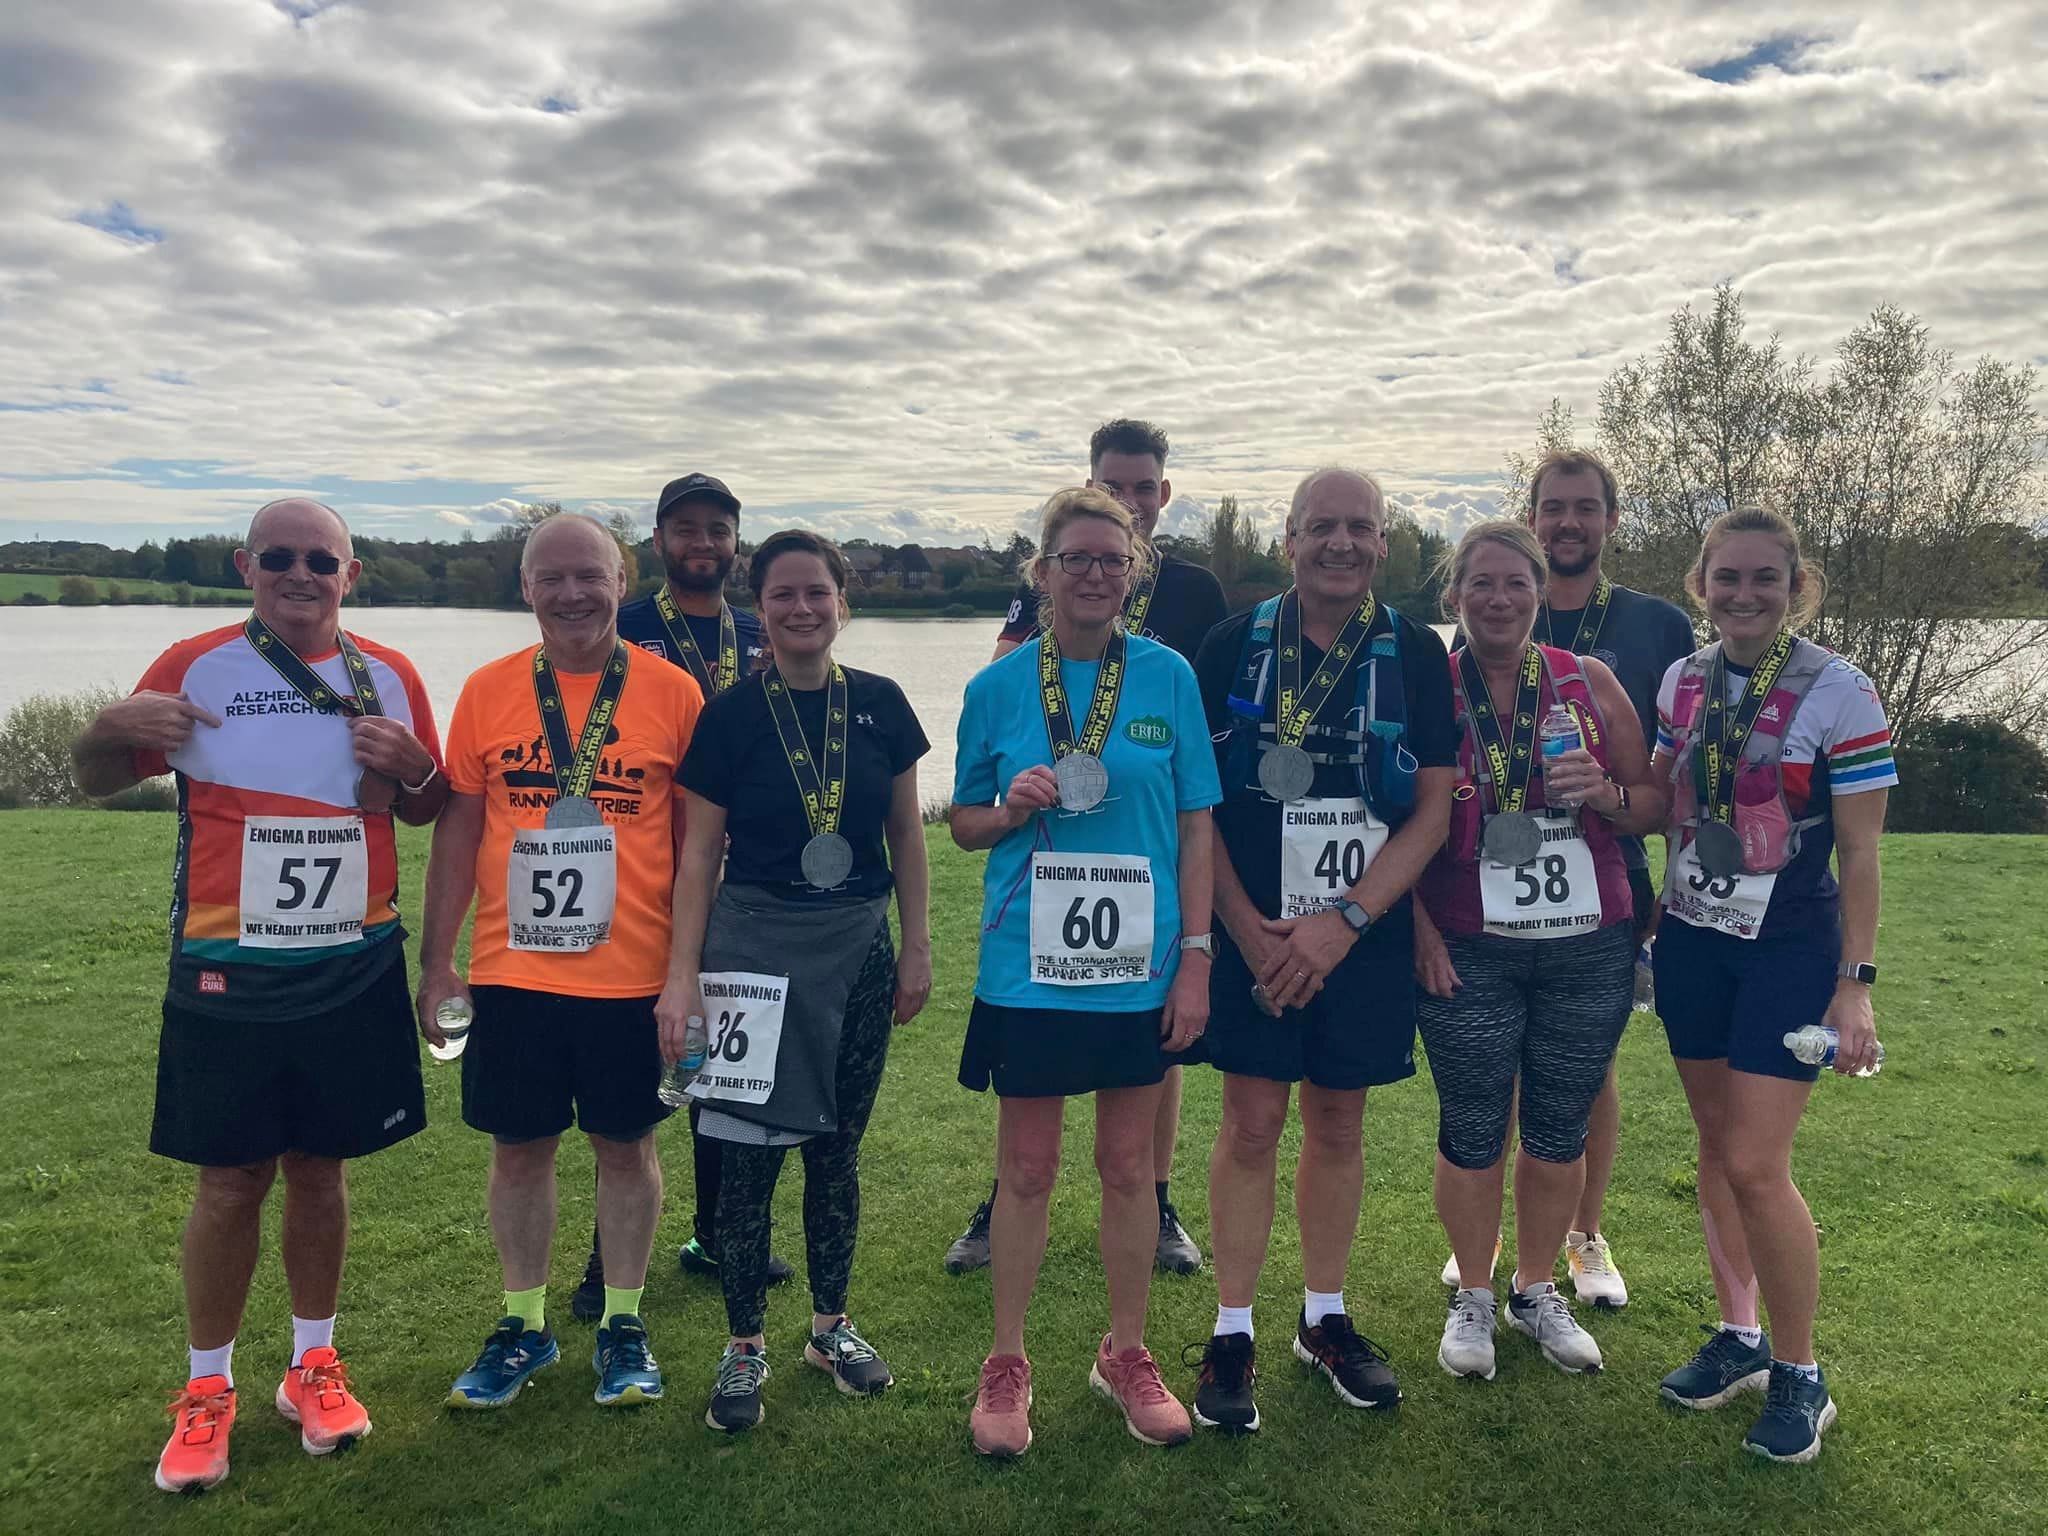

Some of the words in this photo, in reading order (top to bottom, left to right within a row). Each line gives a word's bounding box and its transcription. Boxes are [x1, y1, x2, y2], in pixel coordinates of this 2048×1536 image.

[1134, 595, 1148, 617] RUN
[725, 647, 736, 668] RUN
[1106, 661, 1121, 688] RUN
[1753, 655, 1782, 696] DEATH
[232, 690, 306, 704] ALZHEIM
[1044, 686, 1059, 714] RUN
[1099, 689, 1115, 720] STAR
[225, 702, 314, 718] RESEARCH
[586, 725, 605, 761] STAR
[596, 699, 614, 725] RUN
[1291, 709, 1312, 737] RUN
[1086, 721, 1107, 753] EATH
[828, 780, 841, 808] RUN
[1286, 811, 1338, 826] ENIGMA
[249, 827, 305, 844] ENIGMA
[307, 827, 362, 844] RUNNING
[552, 838, 613, 855] RUNNING
[1314, 838, 1365, 889] 40
[276, 857, 343, 910] 57
[1035, 866, 1087, 881] ENIGMA
[1090, 867, 1150, 884] RUNNING
[1514, 854, 1570, 907] 58
[531, 868, 585, 918] 52
[1287, 894, 1307, 904] THE
[245, 923, 264, 935] WE
[265, 923, 302, 936] NEARLY
[306, 922, 337, 935] THERE
[512, 923, 529, 932] THE
[1062, 896, 1120, 951] 60
[1507, 919, 1542, 930] NEARLY
[1544, 917, 1573, 928] THERE
[1574, 913, 1600, 925] YET?!
[513, 934, 565, 947] RUNNING
[1036, 955, 1056, 964] THE
[1058, 956, 1145, 966] ULTRAMARATHON
[1037, 966, 1095, 981] RUNNING
[1099, 965, 1144, 979] STORE
[201, 981, 225, 991] CURE
[727, 983, 782, 1002] RUNNING
[708, 1010, 749, 1063] 36
[714, 1075, 745, 1089] THERE
[746, 1078, 773, 1093] YET?!
